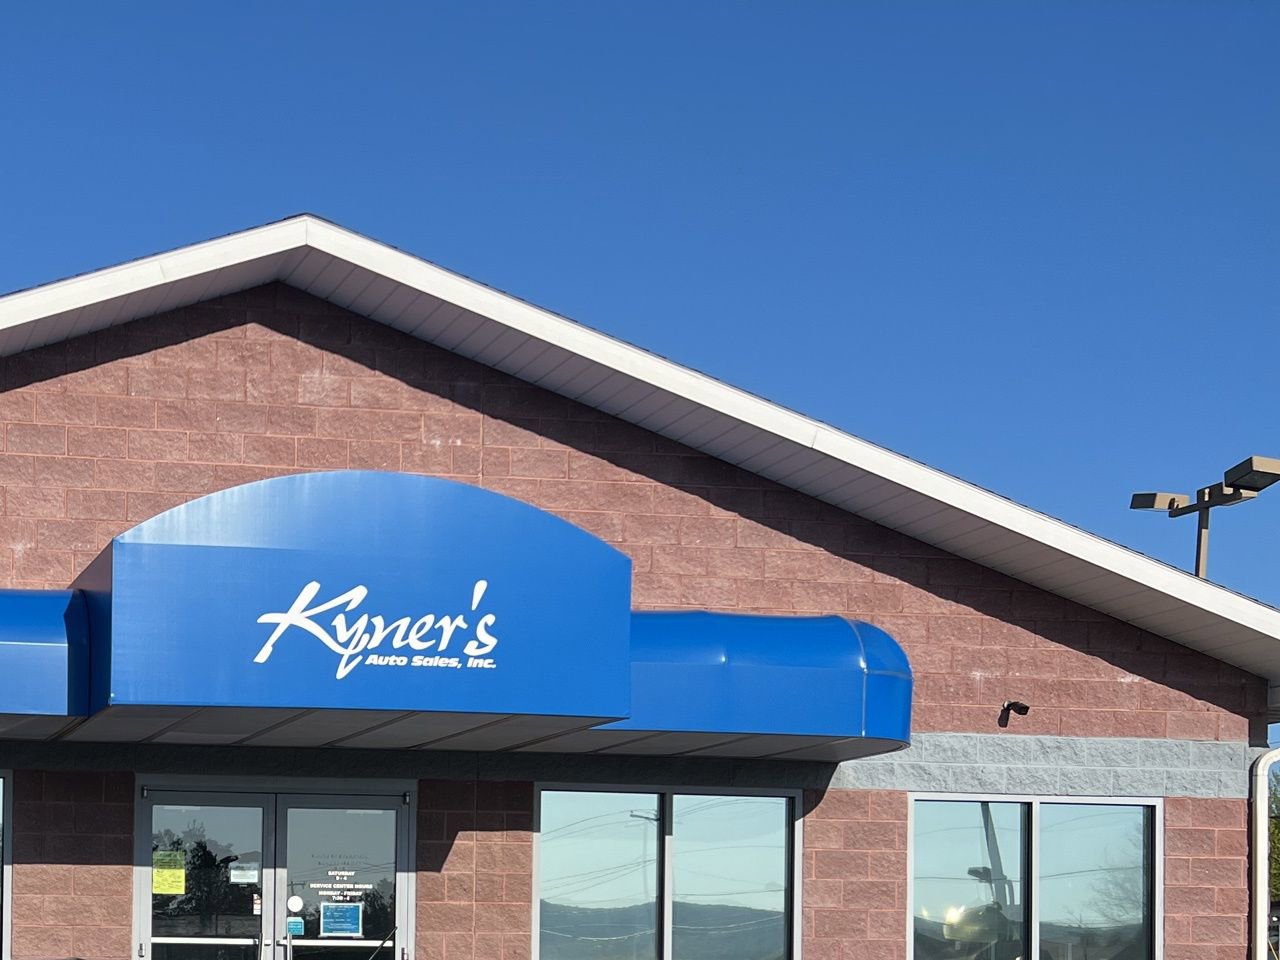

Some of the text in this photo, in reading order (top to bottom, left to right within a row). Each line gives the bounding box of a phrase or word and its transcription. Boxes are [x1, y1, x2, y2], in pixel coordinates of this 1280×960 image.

[253, 580, 498, 680] Kyner's
[365, 654, 497, 669] Auto Sales, Inc.
